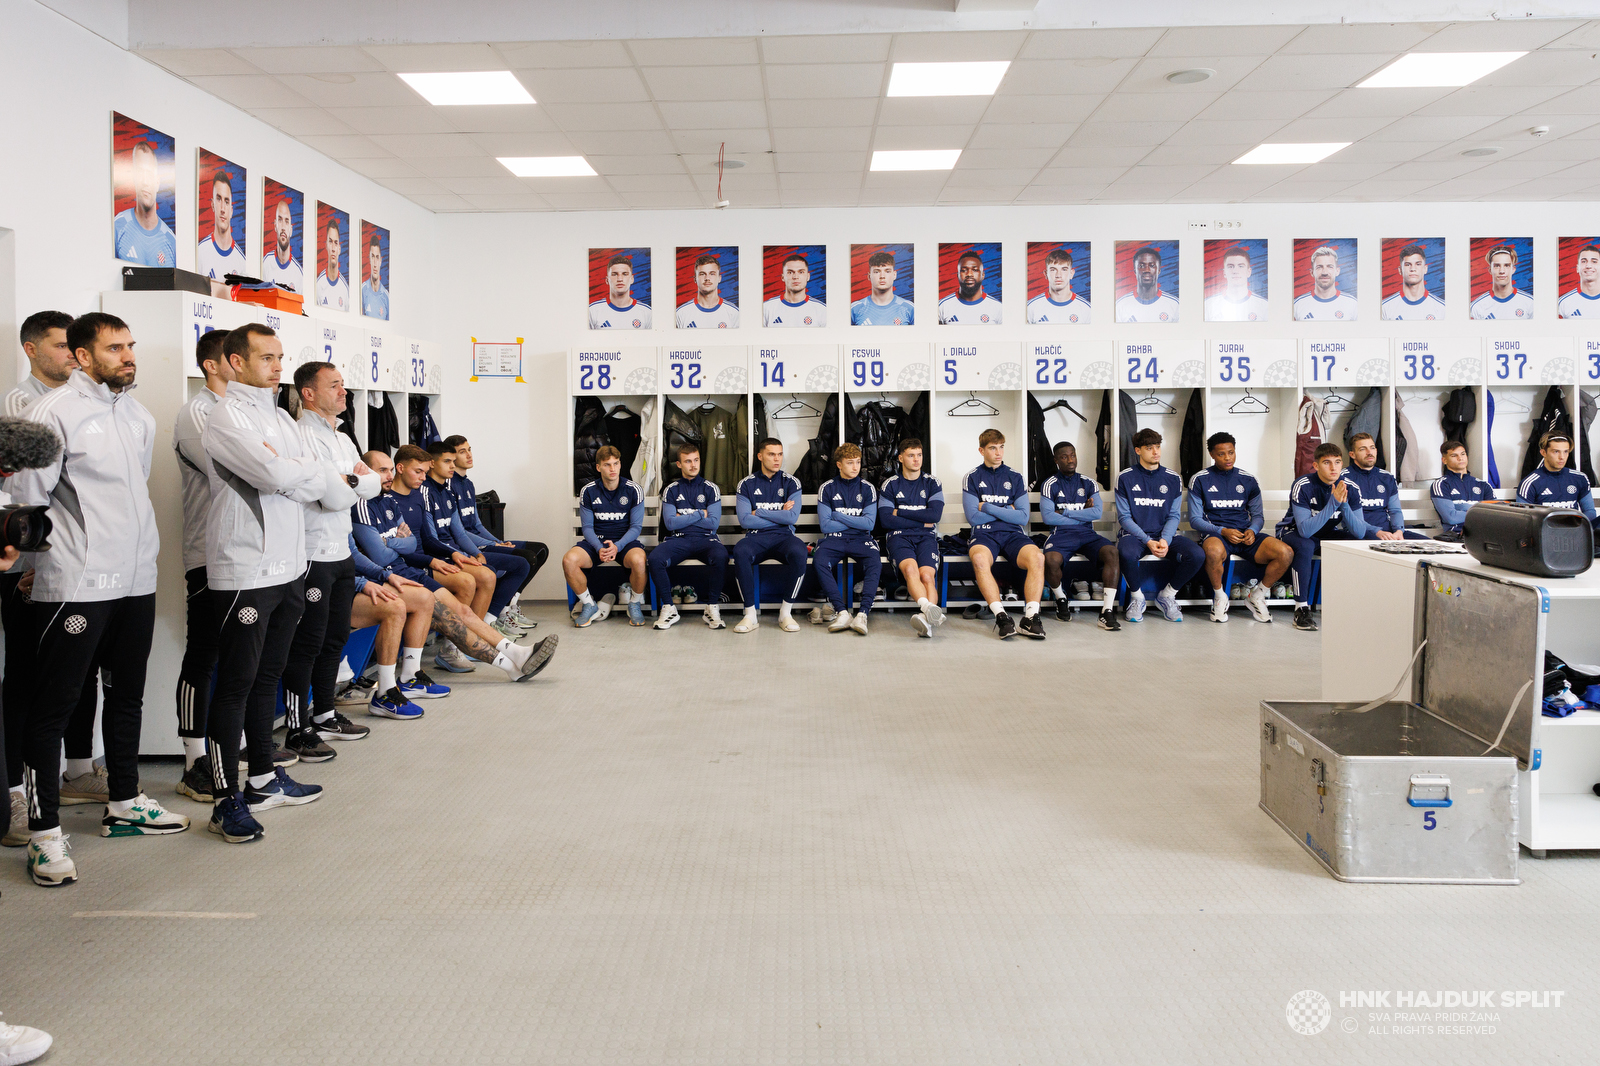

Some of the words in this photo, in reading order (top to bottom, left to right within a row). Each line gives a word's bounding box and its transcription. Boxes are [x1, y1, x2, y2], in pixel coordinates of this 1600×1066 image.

[194, 302, 213, 319] LUČIĆ
[851, 348, 881, 358] FESYUK
[950, 347, 977, 356] DIALLO
[1035, 344, 1062, 355] MLAČIĆ
[1126, 345, 1153, 354] BAMBA
[1218, 344, 1245, 353] JURAK
[1310, 343, 1346, 352] MELNJAK
[1494, 341, 1520, 350] SKOKO
[579, 351, 621, 362] BRAJKOVIĆ
[669, 349, 702, 360] HRGOVIĆ
[760, 349, 778, 360] RAÇI
[371, 351, 379, 382] 8
[411, 358, 425, 388] 33
[760, 362, 785, 387] 14
[853, 361, 884, 387] 99
[944, 359, 958, 385] 5
[1036, 358, 1067, 384] 22
[1127, 357, 1159, 383] 24
[1219, 356, 1251, 382] 35
[1311, 355, 1336, 381] 17
[1404, 354, 1435, 380] 38
[1496, 353, 1527, 379] 37
[580, 365, 611, 390] 28
[670, 363, 701, 389] 32
[981, 494, 1009, 504] TOMMY
[1134, 497, 1166, 508] TOMMY
[1210, 500, 1244, 508] TOMMY
[594, 512, 627, 521] TOMMY
[98, 573, 122, 590] D.F.
[1423, 811, 1437, 831] 5
